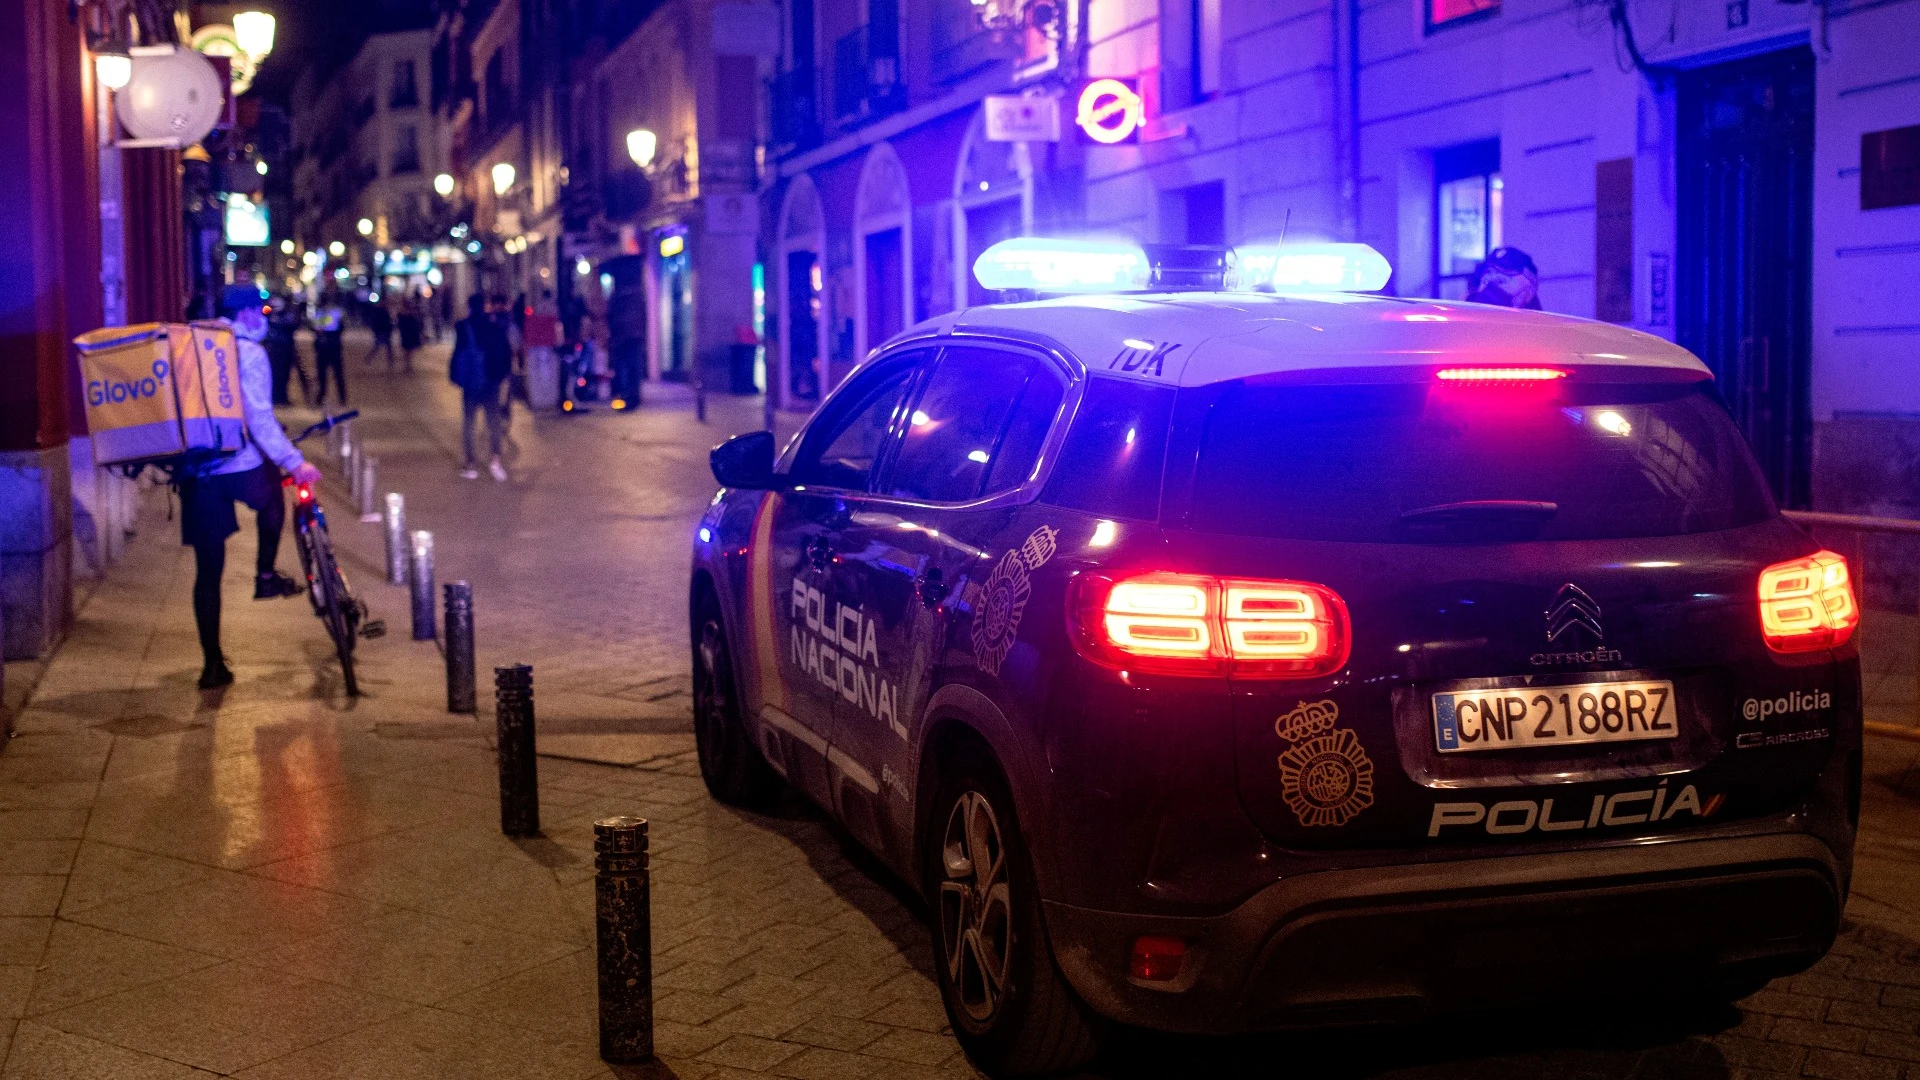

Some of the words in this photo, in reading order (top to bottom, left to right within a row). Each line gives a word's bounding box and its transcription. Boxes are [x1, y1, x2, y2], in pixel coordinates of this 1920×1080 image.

[87, 377, 157, 407] Glovo
[214, 348, 234, 409] Glovo
[791, 577, 879, 668] POLICÍA
[791, 624, 908, 743] NACIONAL
[1742, 688, 1831, 721] @policia
[1443, 728, 1453, 741] E
[1428, 778, 1702, 837] POLICÍA
